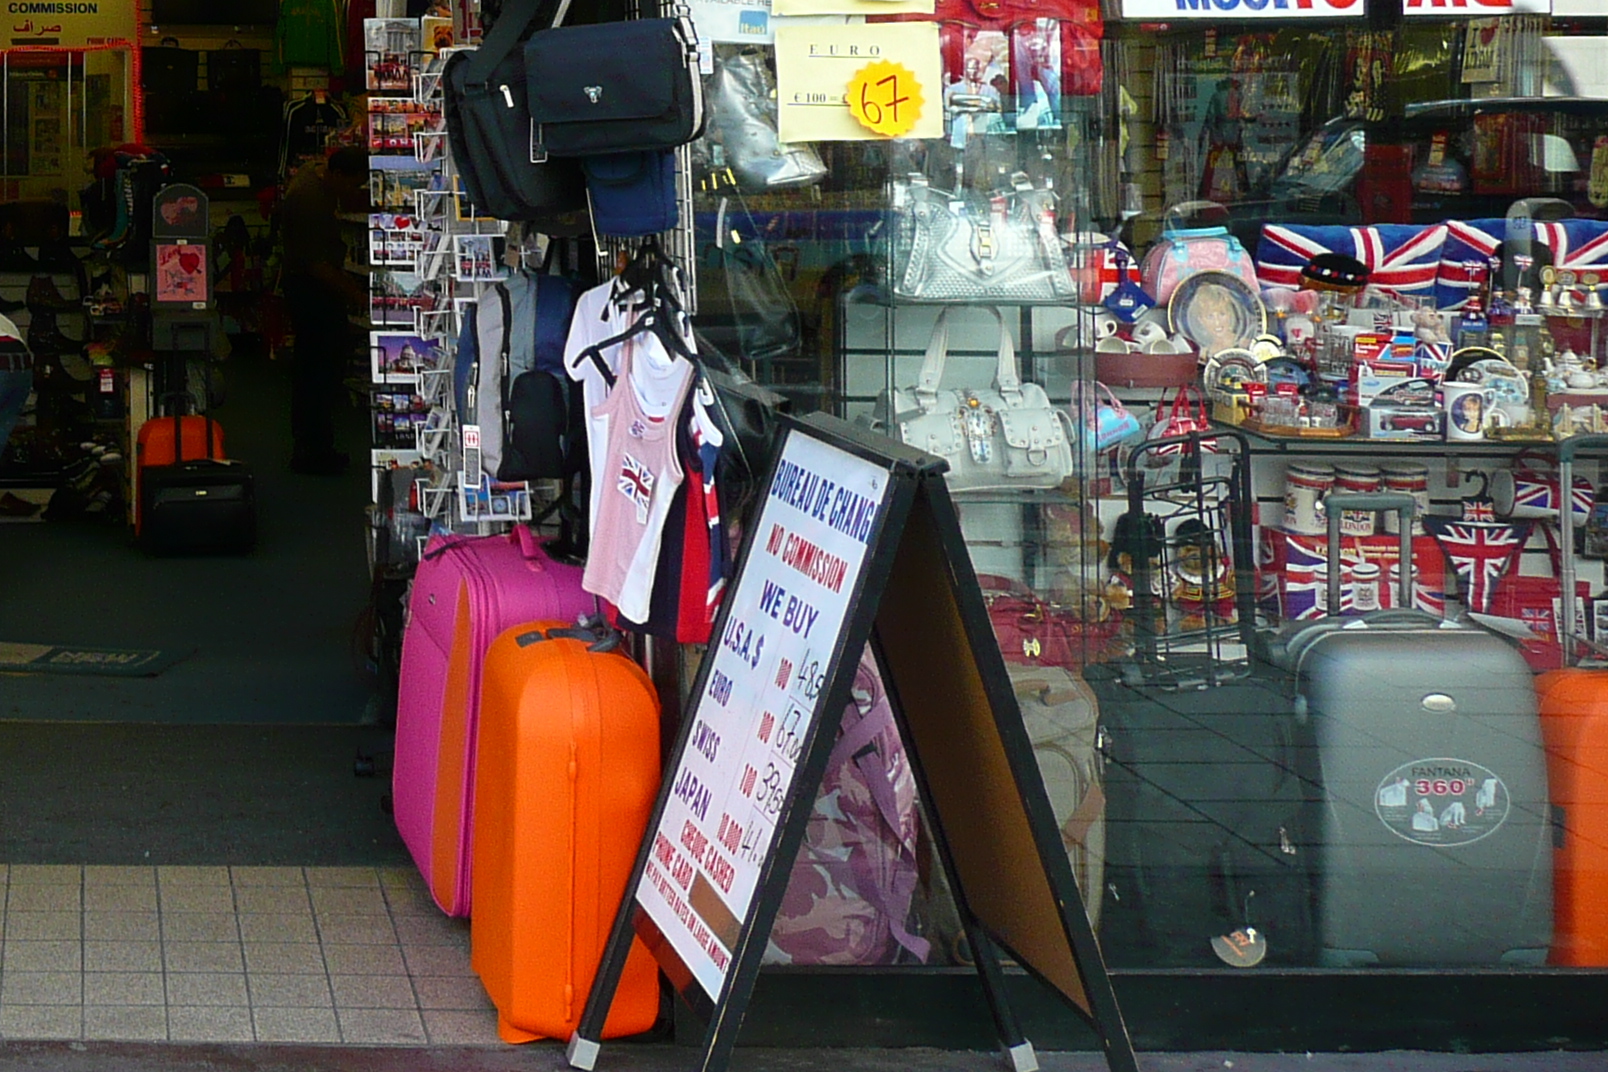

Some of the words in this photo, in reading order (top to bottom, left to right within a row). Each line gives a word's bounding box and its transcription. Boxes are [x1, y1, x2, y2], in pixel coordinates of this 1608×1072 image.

[8, 2, 98, 15] COMMISSION
[809, 44, 880, 56] EURO
[861, 74, 909, 124] 67
[771, 458, 817, 517] BUREAU
[813, 482, 835, 522] DE
[765, 522, 785, 556] NO
[782, 532, 849, 594] COMMISSION
[758, 579, 786, 619] WE
[783, 595, 819, 640] BUY
[707, 668, 734, 708] EURO
[691, 719, 721, 764] SWISS
[674, 766, 713, 823] JAPAN
[1411, 766, 1472, 778] FANTANA
